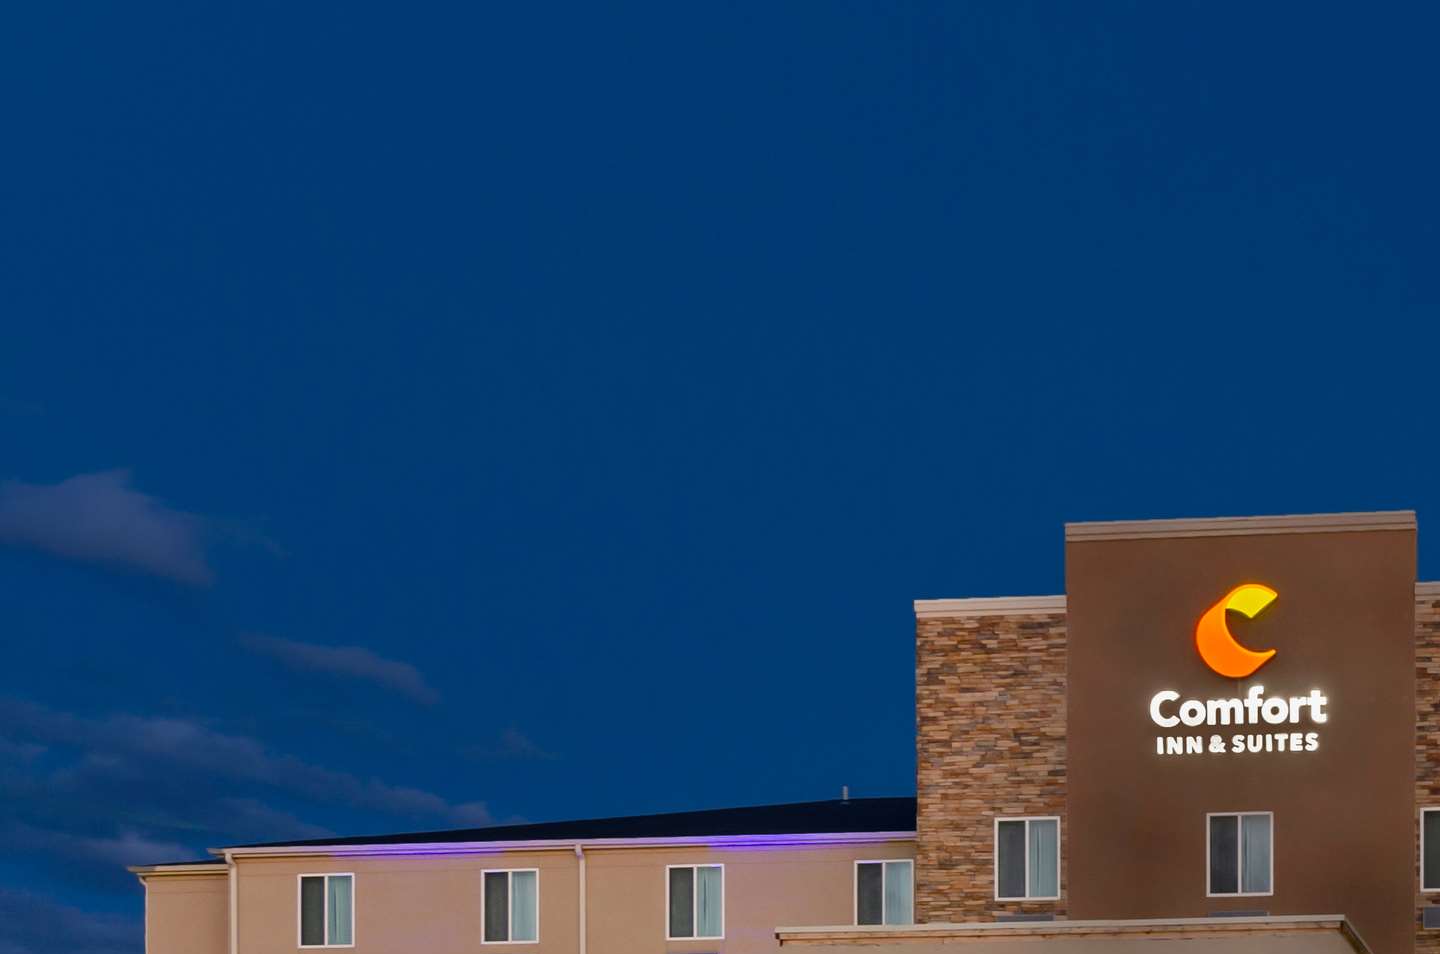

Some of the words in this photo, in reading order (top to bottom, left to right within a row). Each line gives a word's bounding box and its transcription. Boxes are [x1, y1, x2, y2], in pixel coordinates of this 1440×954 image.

[1150, 685, 1328, 727] Comfort
[1156, 736, 1203, 754] INN
[1208, 735, 1226, 753] &
[1231, 732, 1319, 753] SUITES
